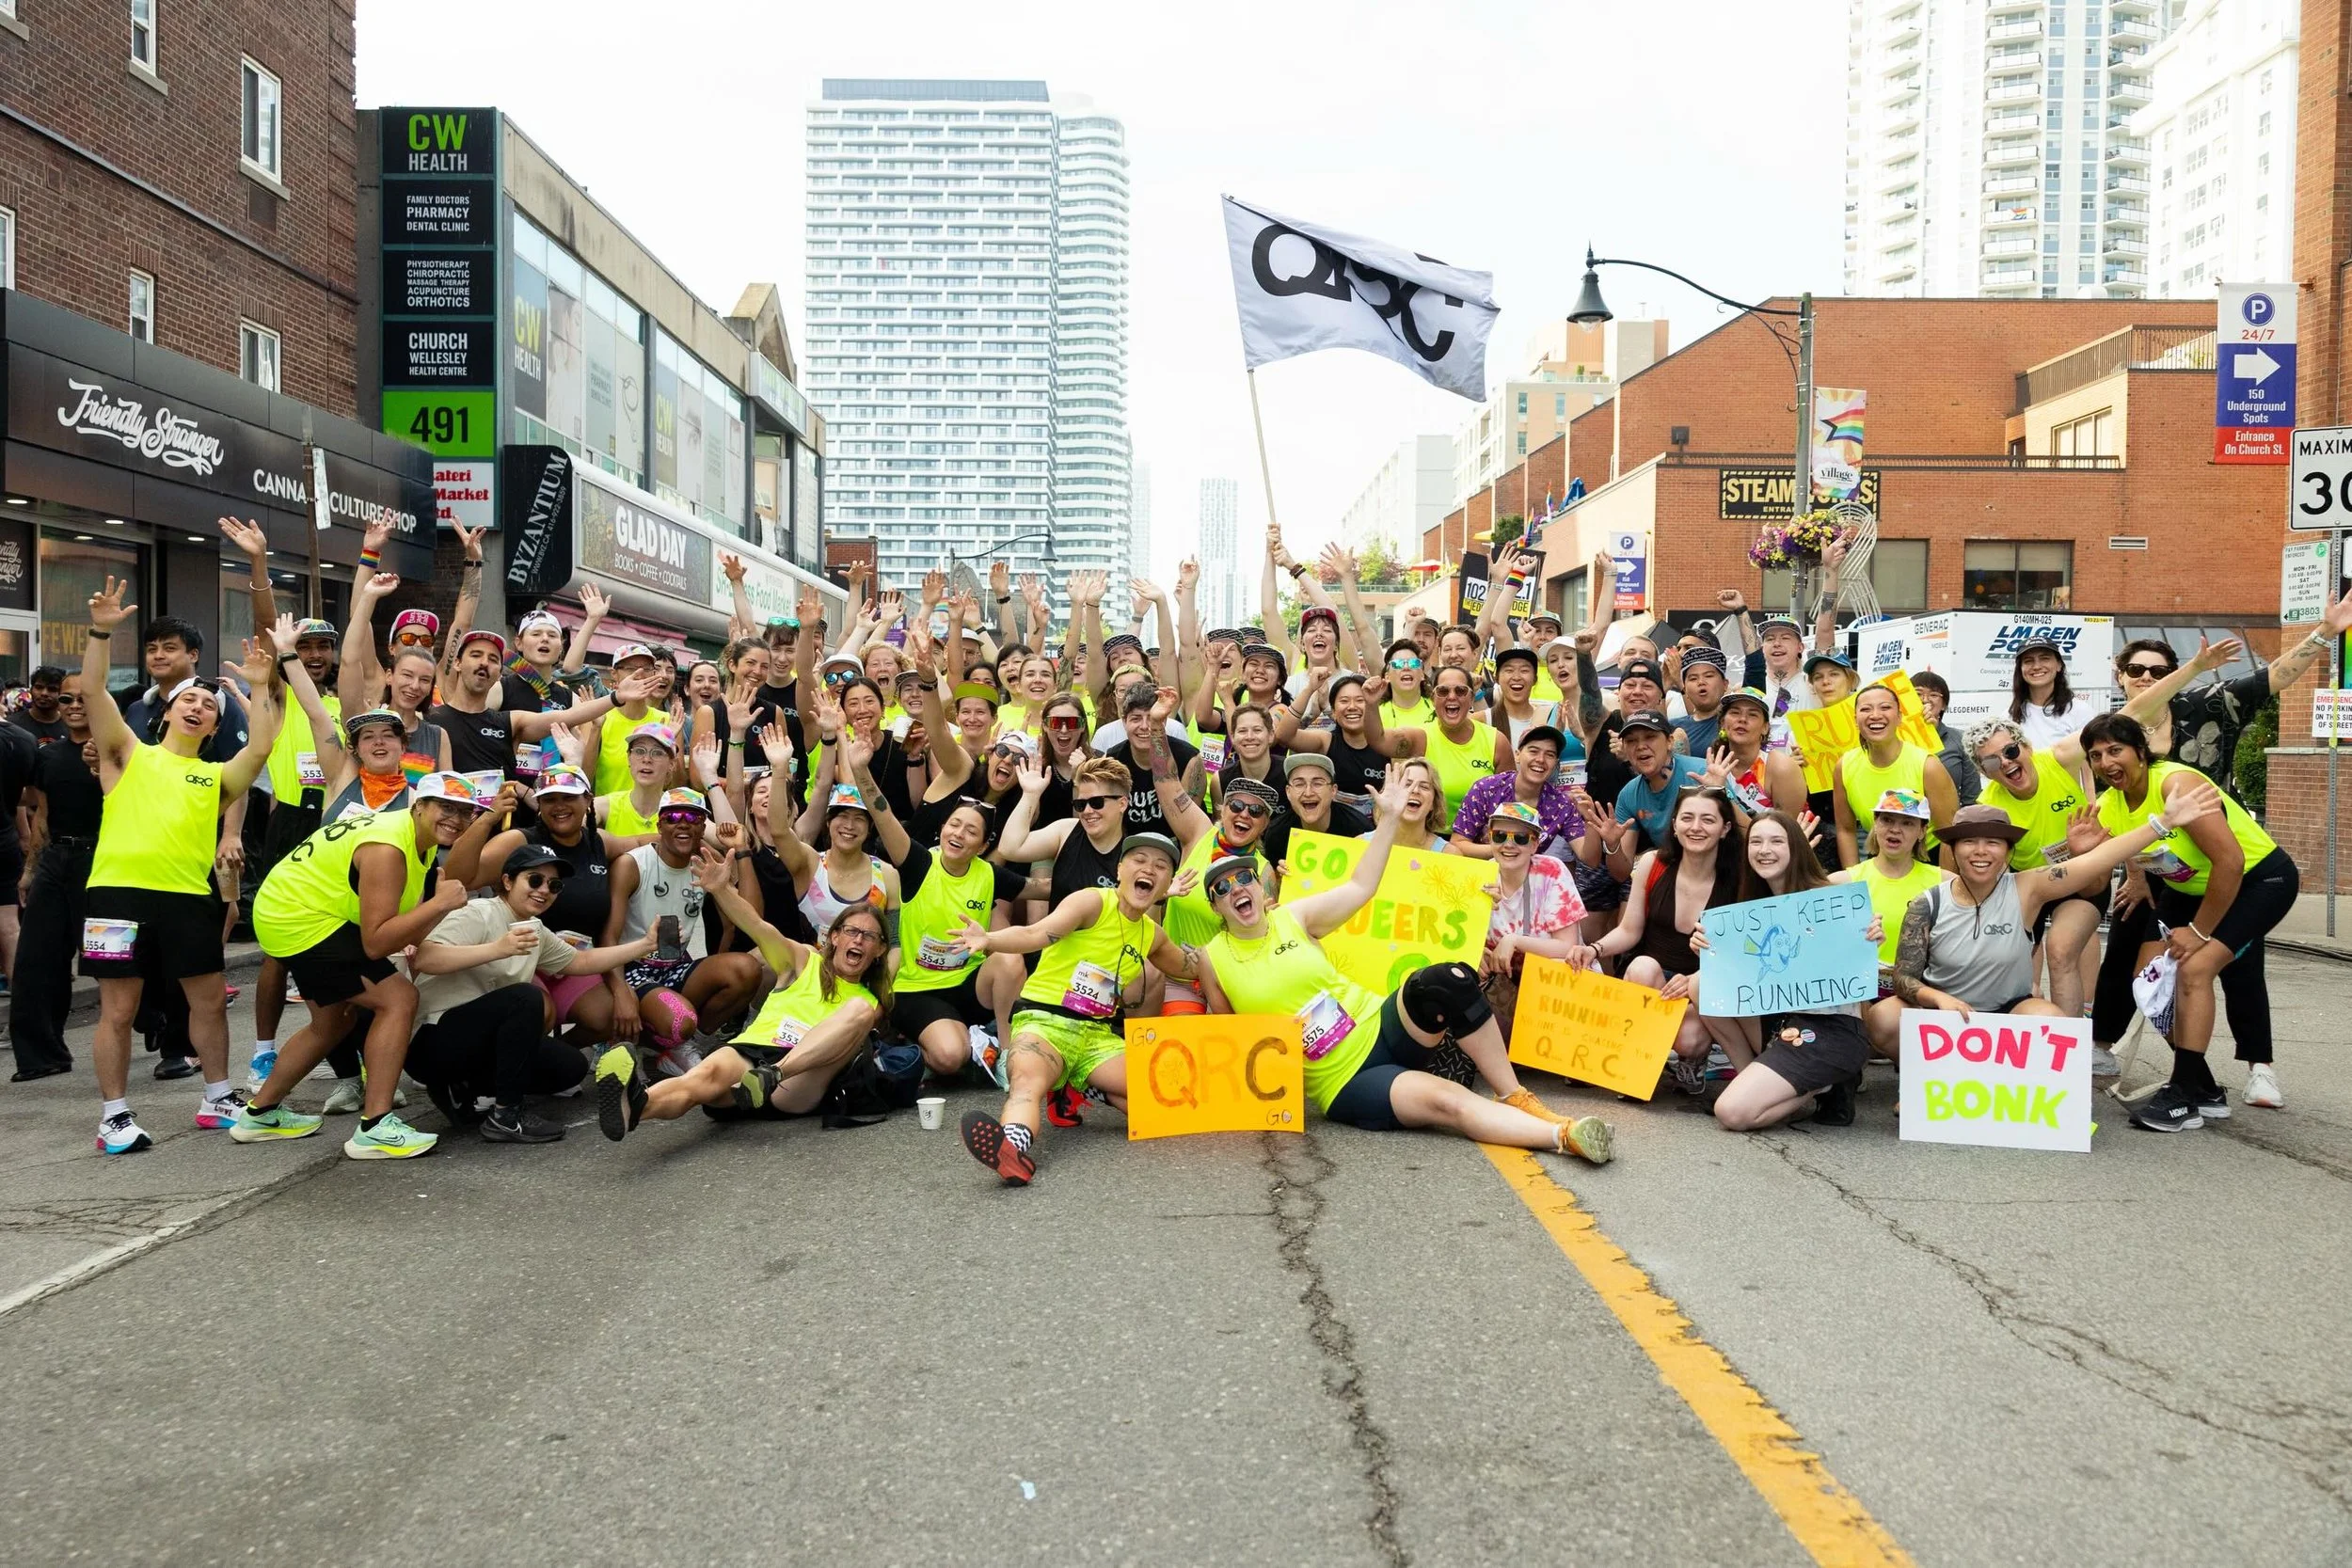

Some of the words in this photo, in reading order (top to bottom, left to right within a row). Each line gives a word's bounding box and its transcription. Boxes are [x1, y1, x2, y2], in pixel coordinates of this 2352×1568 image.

[408, 114, 467, 150] CW
[408, 153, 468, 171] HEALTH
[406, 195, 433, 204] FAMILY
[435, 196, 469, 204] DOCTORS
[406, 207, 469, 218] PHARMACY
[406, 222, 438, 231] DENTAL
[441, 222, 469, 231] CLINIC
[406, 260, 469, 269] PHYSIOTHERAPY
[406, 269, 470, 278] CHIROPRACTIC
[407, 287, 469, 295] ACUPUNCTURE
[406, 296, 470, 308] ORTHOTICS
[515, 294, 541, 354] CW
[408, 332, 468, 350] CHURCH
[2241, 329, 2275, 341] 24/7
[409, 352, 468, 364] WELLESLEY
[515, 344, 541, 382] HEALTH
[409, 366, 437, 376] HEALTH
[438, 366, 468, 376] CENTRE
[2248, 388, 2265, 400] 150
[2227, 401, 2286, 412] Underground
[410, 406, 469, 443] 491
[2243, 413, 2268, 424] Spots
[57, 377, 148, 449] Friendly
[142, 407, 224, 476] Stranger
[2235, 431, 2275, 441] Entrance
[2224, 444, 2237, 455] On
[2238, 443, 2270, 455] Church
[433, 469, 472, 483] ateri
[1820, 467, 1853, 483] village
[253, 468, 308, 505] CANNA
[329, 491, 384, 525] CULTURE
[436, 487, 489, 501] Market
[1726, 478, 1874, 505] STEAMS
[436, 506, 455, 519] td.
[507, 452, 569, 586] BYZANTIUM
[615, 504, 659, 558] GLAD
[659, 523, 687, 570] DAY
[614, 552, 634, 573] BOOKS
[640, 562, 659, 581] COFFEE
[662, 570, 687, 591] COCKTAILS
[1512, 601, 1529, 612] DGE
[2299, 607, 2320, 616] 3803
[1915, 619, 1948, 634] GENERAC
[2013, 614, 2052, 625] G140MH-025
[1996, 626, 2032, 639] LM
[2033, 626, 2082, 641] GEN
[1888, 640, 1903, 653] GEN
[1873, 651, 1902, 666] POWER
[481, 728, 505, 739] QRC
[1202, 752, 1220, 764] 3558
[1471, 759, 1492, 770] QRC
[184, 773, 215, 788] QRC
[303, 769, 324, 780] 353
[2051, 795, 2076, 813] QRC
[1128, 804, 1163, 822] CLU
[1295, 841, 1349, 880] GO
[966, 899, 986, 911] QRC
[1711, 905, 1777, 937] JUST
[1798, 893, 1866, 926] KEEP
[1347, 899, 1469, 951] UEERS
[1983, 923, 2013, 937] QRC
[1274, 940, 1299, 957] QRC
[921, 953, 946, 966] 3543
[1538, 967, 1579, 989] WHY
[1073, 982, 1099, 1001] 3524
[1737, 976, 1867, 1015] RUNNING
[779, 1034, 800, 1045] 353
[1132, 1027, 1156, 1047] GO
[1918, 1023, 2078, 1072] DON'T
[1149, 1036, 1288, 1110] QRC
[1923, 1080, 2069, 1130] BONK
[1266, 1108, 1293, 1126] GO
